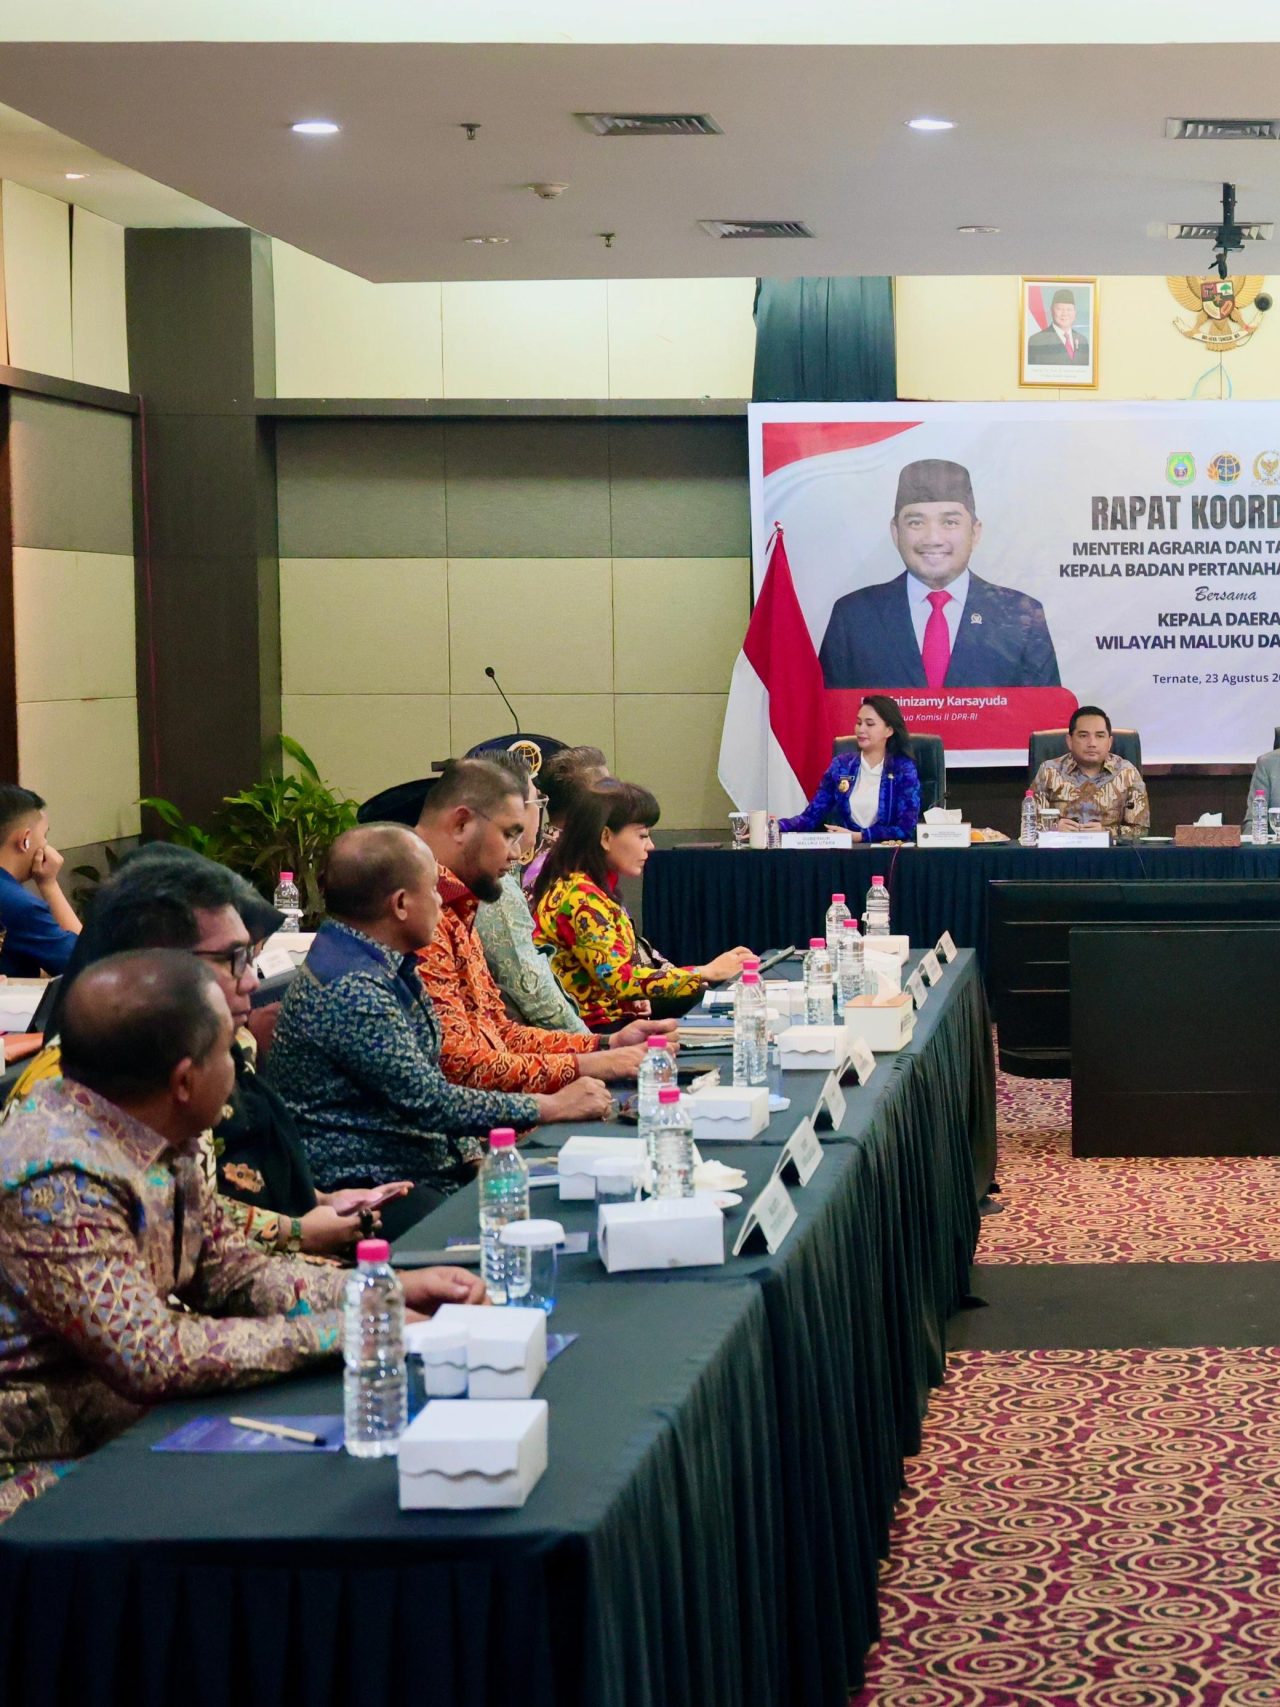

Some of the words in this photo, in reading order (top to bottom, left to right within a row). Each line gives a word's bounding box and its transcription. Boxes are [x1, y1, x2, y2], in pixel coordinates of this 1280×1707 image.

[1091, 495, 1181, 531] RAPAT
[1072, 541, 1145, 556] MENTERI
[1148, 541, 1222, 555] AGRARIA
[1225, 540, 1263, 555] DAN
[1059, 563, 1122, 578] KEPALA
[1125, 563, 1185, 577] BADAN
[1195, 586, 1258, 602] Bersama
[1157, 612, 1222, 627] KEPALA
[1095, 635, 1177, 650] WILAYAH
[1180, 634, 1255, 649] MALUKU
[1152, 673, 1202, 685] Ternate,
[1205, 673, 1219, 684] 23
[1222, 673, 1270, 686] Agustus
[947, 696, 1008, 709] Karsayuda
[916, 713, 943, 721] Komisi
[943, 713, 950, 721] II
[951, 713, 978, 721] DPR-RI
